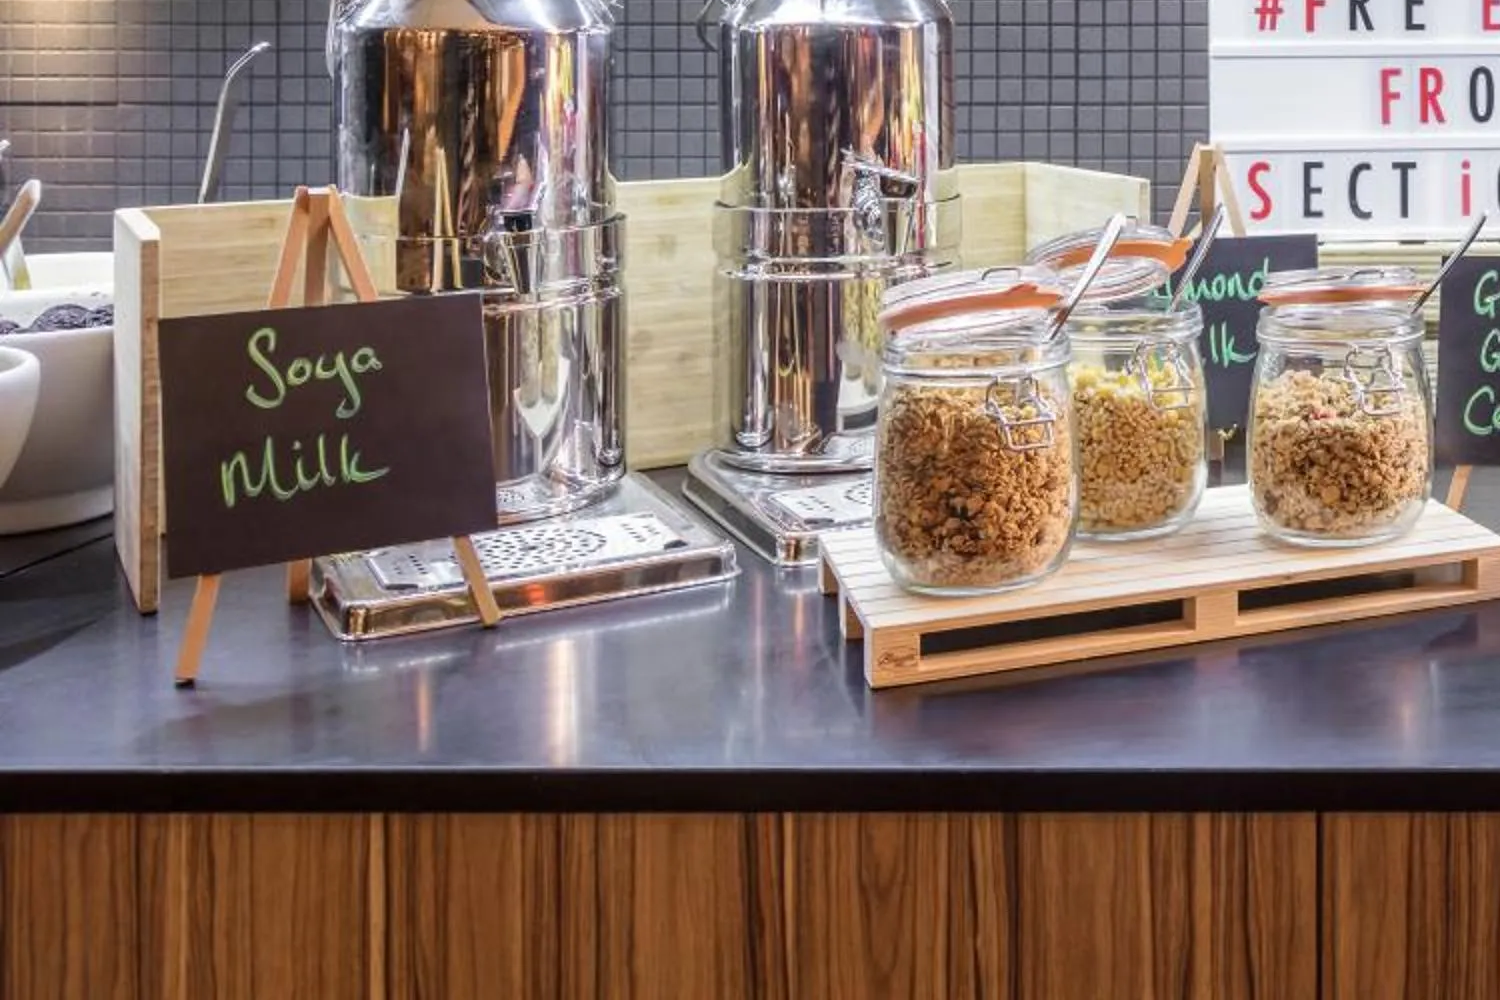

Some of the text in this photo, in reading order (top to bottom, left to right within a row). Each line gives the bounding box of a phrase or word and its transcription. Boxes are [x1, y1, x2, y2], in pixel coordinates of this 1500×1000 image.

[1150, 256, 1269, 311] mond
[245, 326, 384, 419] Soya
[1209, 320, 1258, 369] lk
[220, 432, 391, 509] Milk
